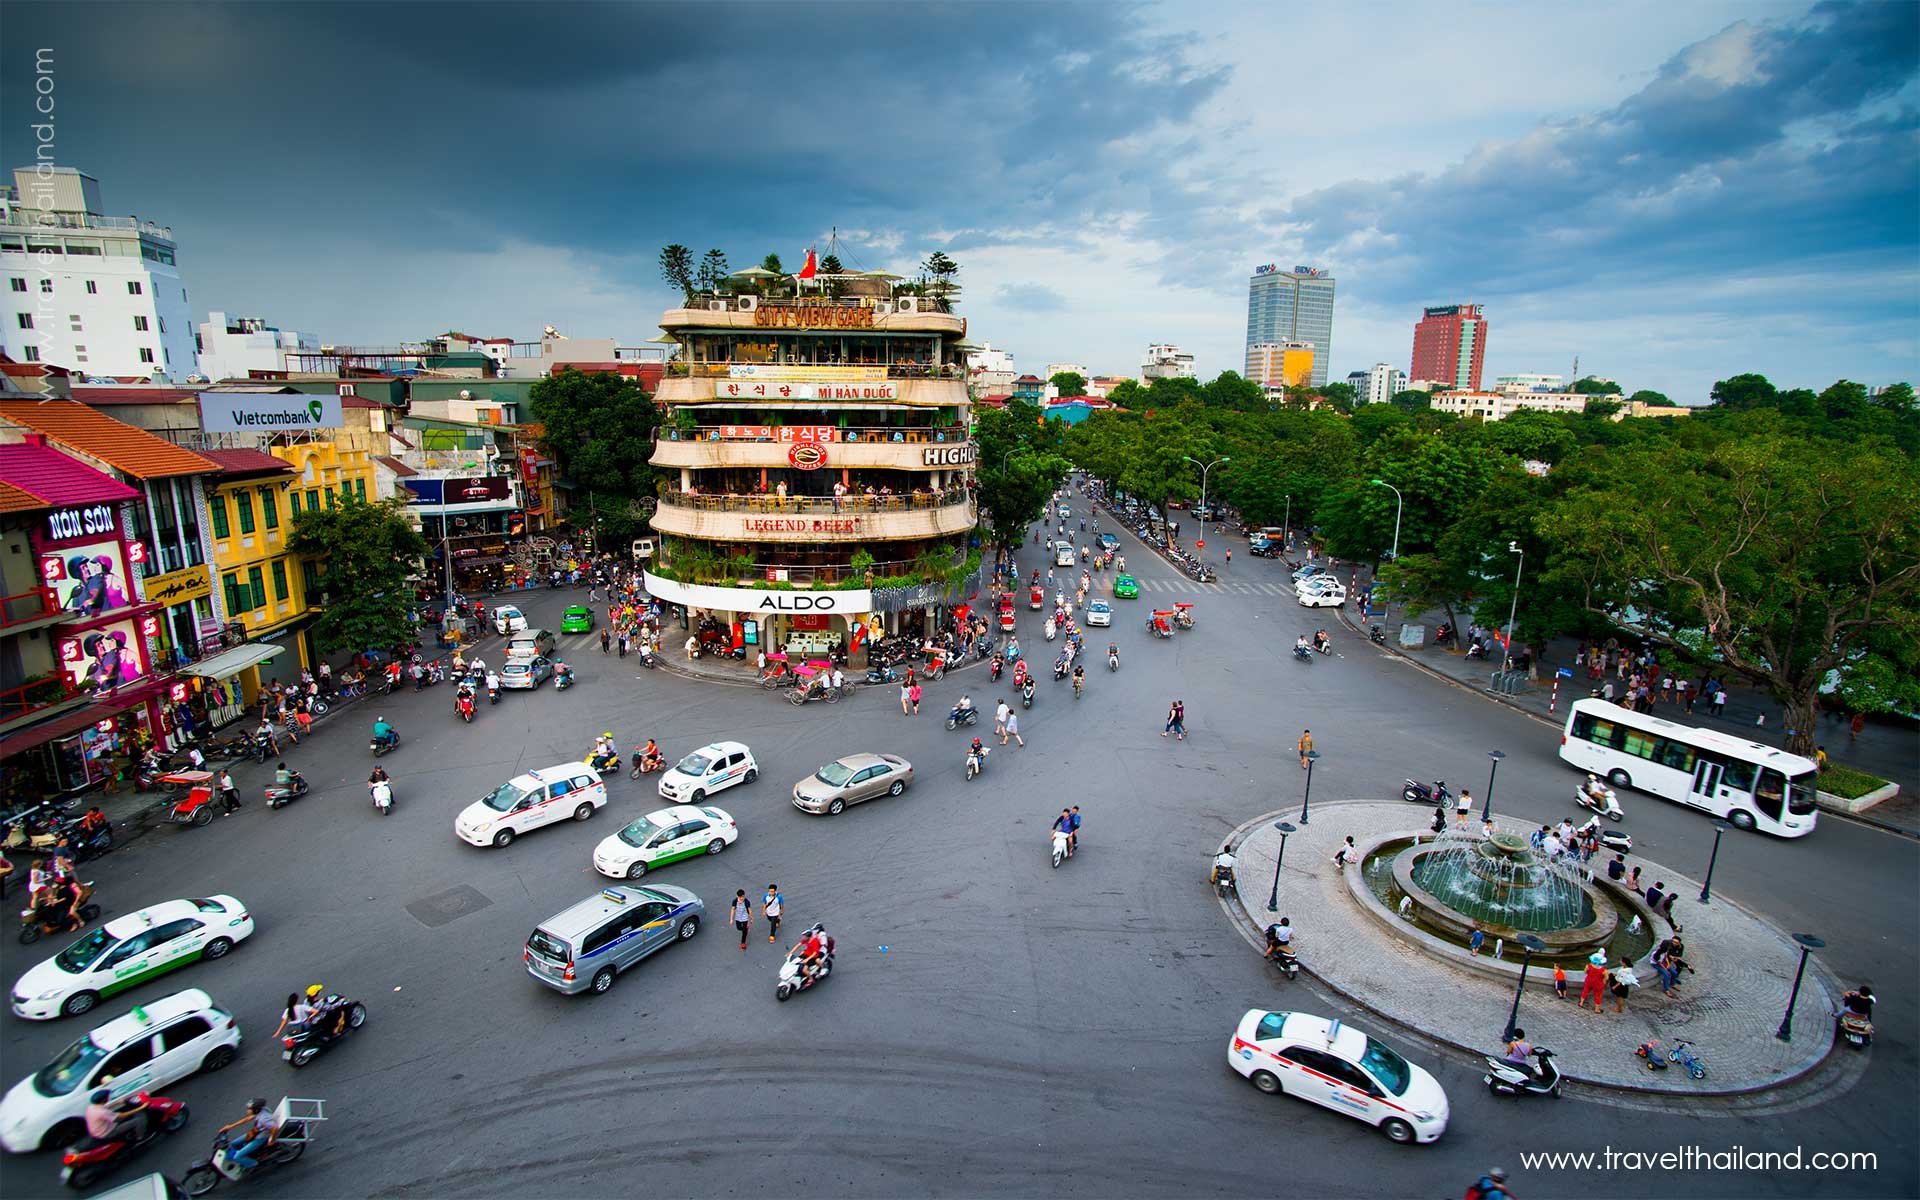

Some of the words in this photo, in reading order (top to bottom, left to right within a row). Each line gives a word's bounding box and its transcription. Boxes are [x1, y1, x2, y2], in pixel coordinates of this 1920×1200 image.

[755, 306, 789, 327] CITY
[793, 306, 833, 327] VIEW
[835, 306, 873, 327] CAFE
[728, 384, 792, 397] 한식당
[818, 385, 832, 398] MÌ
[836, 384, 860, 398] HÀN
[863, 384, 893, 398] QUỐC
[232, 410, 311, 425] Vietcombank
[727, 426, 771, 436] 하노이
[780, 427, 833, 442] 한식당
[49, 508, 83, 539] NÓN
[745, 519, 807, 532] LEGEND
[813, 520, 854, 532] BEER
[759, 596, 836, 610] ALDO
